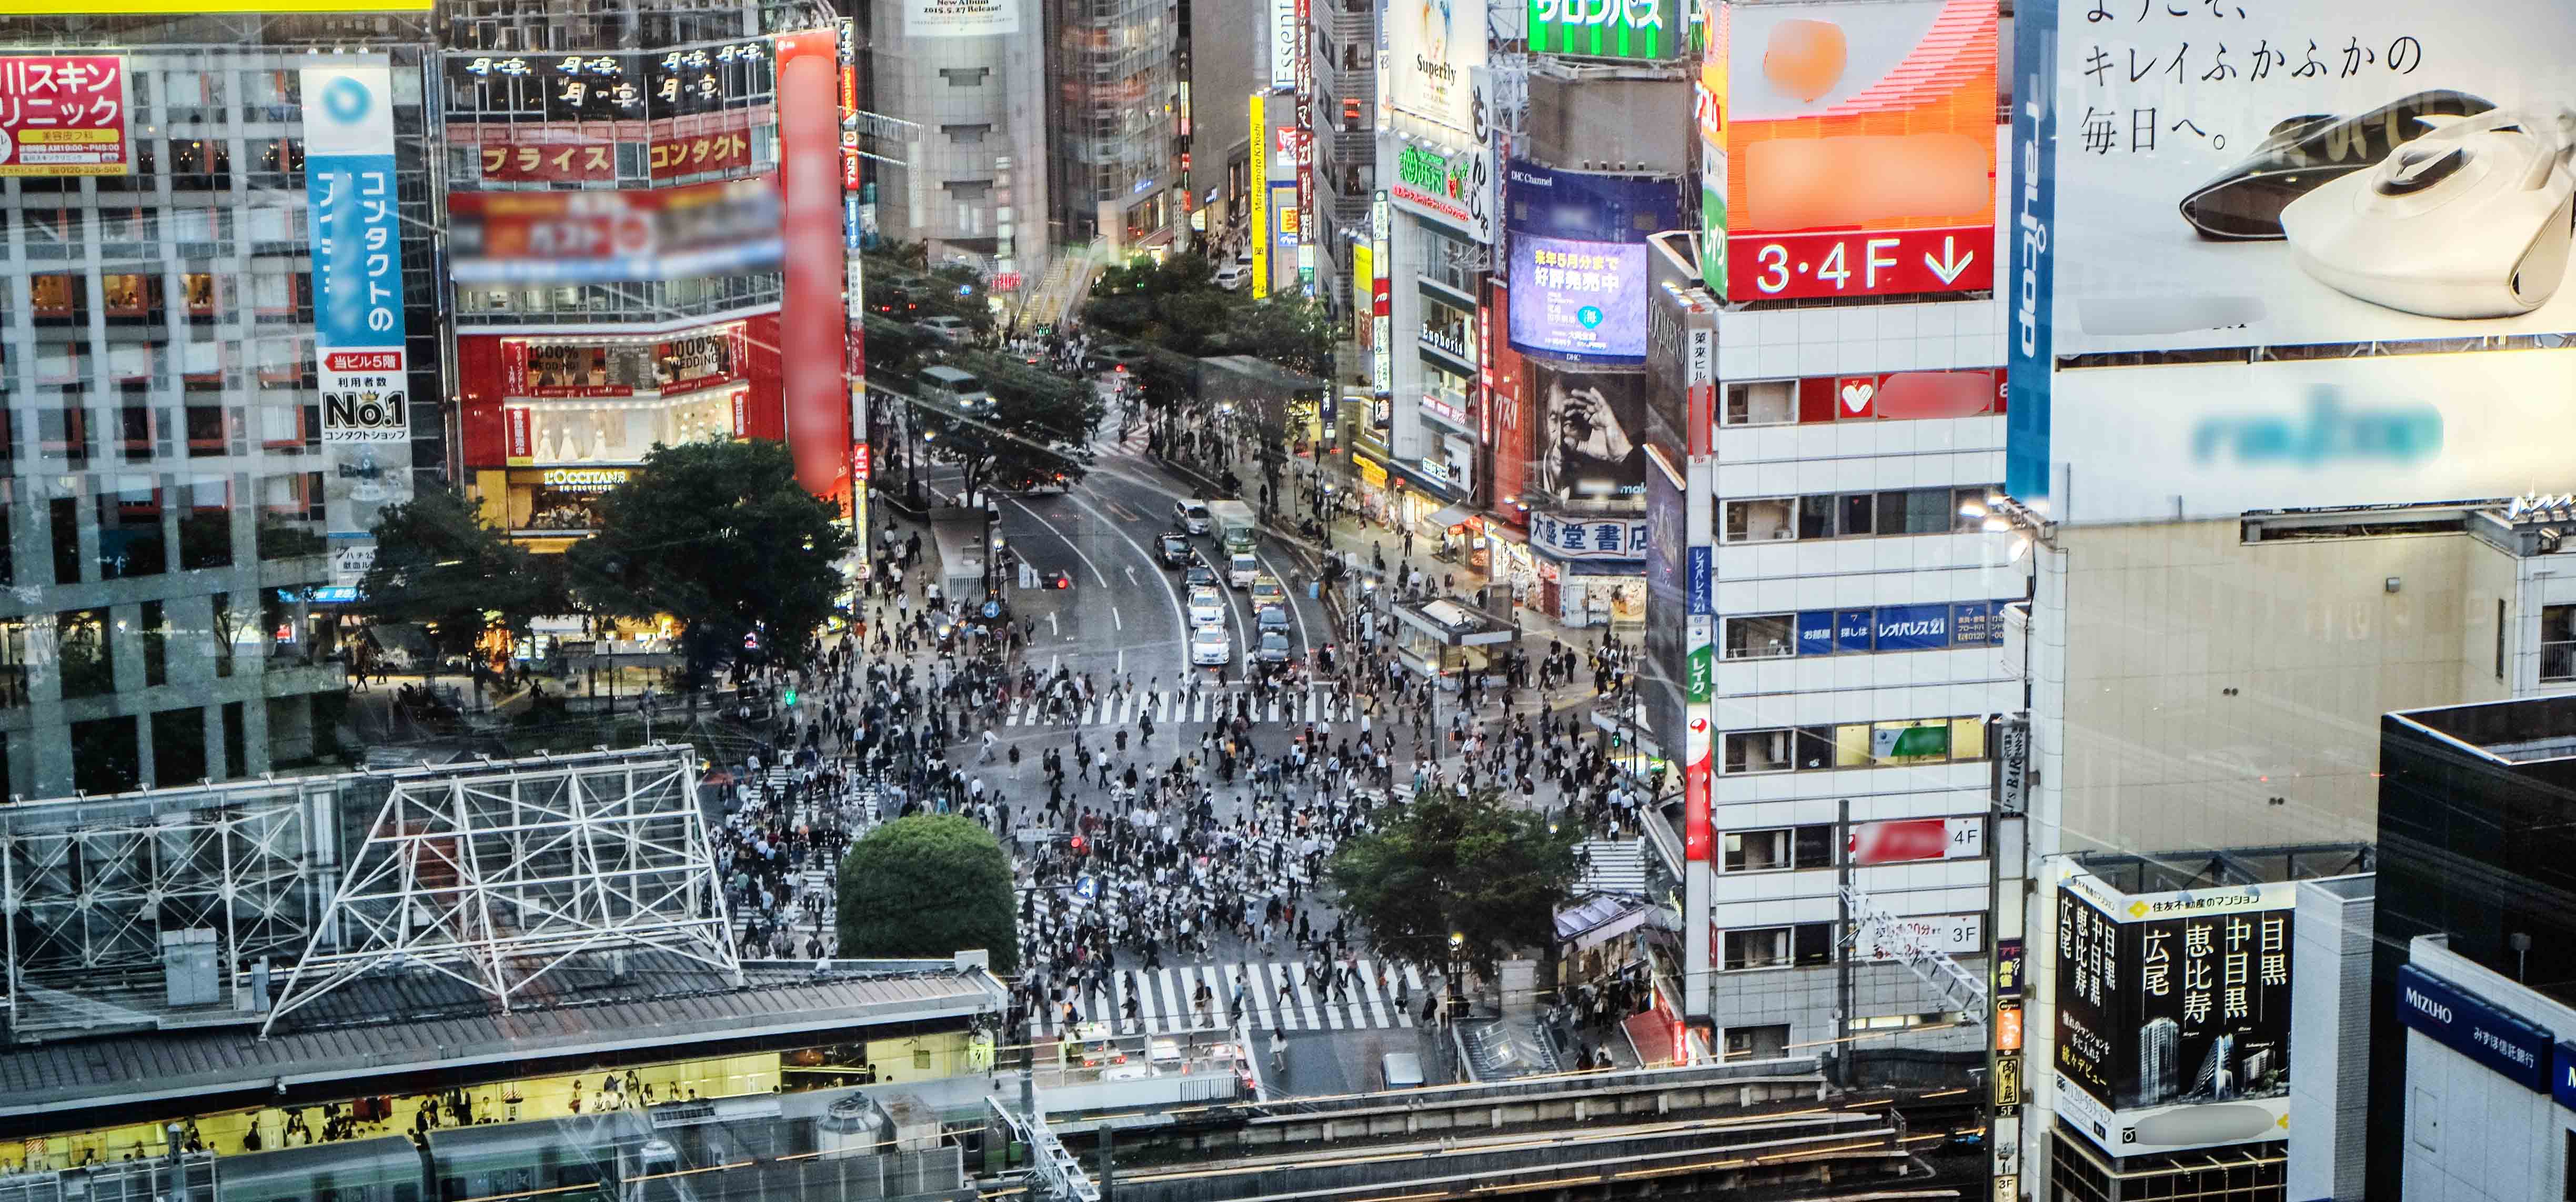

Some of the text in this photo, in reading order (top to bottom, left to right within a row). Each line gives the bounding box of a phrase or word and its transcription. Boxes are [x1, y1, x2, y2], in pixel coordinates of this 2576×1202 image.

[968, 4, 1002, 13] Release!
[1417, 53, 1456, 86] Superfly
[2084, 36, 2422, 87] キレイふかふかの
[2081, 106, 2226, 155] 毎日へ。
[482, 147, 611, 172] プライス
[651, 135, 748, 169] コンタクト
[1471, 85, 1488, 238] もんじゃ
[1511, 171, 1552, 186] DHC Channel
[361, 172, 394, 332] コンタクトの
[1535, 249, 1619, 271] 来年5月分まで
[1535, 266, 1619, 293] 好評発売中
[528, 345, 579, 358] 1000%
[670, 334, 721, 358] 1000%
[1422, 323, 1463, 355] Euphoria
[334, 354, 396, 369] 当ビル5階
[338, 377, 387, 388] 利用者数
[323, 390, 406, 429] No.1
[324, 430, 406, 441] コンタクトショップ
[544, 470, 626, 485] L'OCCITANE
[1533, 513, 1646, 551] 大盛堂書店
[1694, 549, 1705, 613] レオパレス21
[1804, 618, 1945, 640] お部屋 探しは レオパレス21
[1692, 657, 1706, 695] レイク
[1954, 829, 1978, 845] 4F
[2152, 896, 2259, 913] 住友不動産のマンション
[1953, 927, 1976, 943] 3F
[2061, 896, 2072, 959] 広尾
[2076, 905, 2088, 998] 恵比寿
[2090, 913, 2102, 1008] 中目黒
[2105, 925, 2115, 991] 目黒
[2144, 929, 2171, 996] 広尾
[2225, 917, 2251, 1019] 中目黒
[2261, 917, 2287, 986] 目黒
[2185, 924, 2214, 1024] 恵比寿
[2405, 986, 2452, 1024] MIZUHO
[2062, 1010, 2110, 1055] 憧れのマンションを
[2072, 1034, 2100, 1063] 手に入れる
[2474, 1027, 2534, 1068] みずほ信託銀行
[2062, 1044, 2107, 1086] 続々デビュー
[1999, 1179, 2013, 1189] 3F
